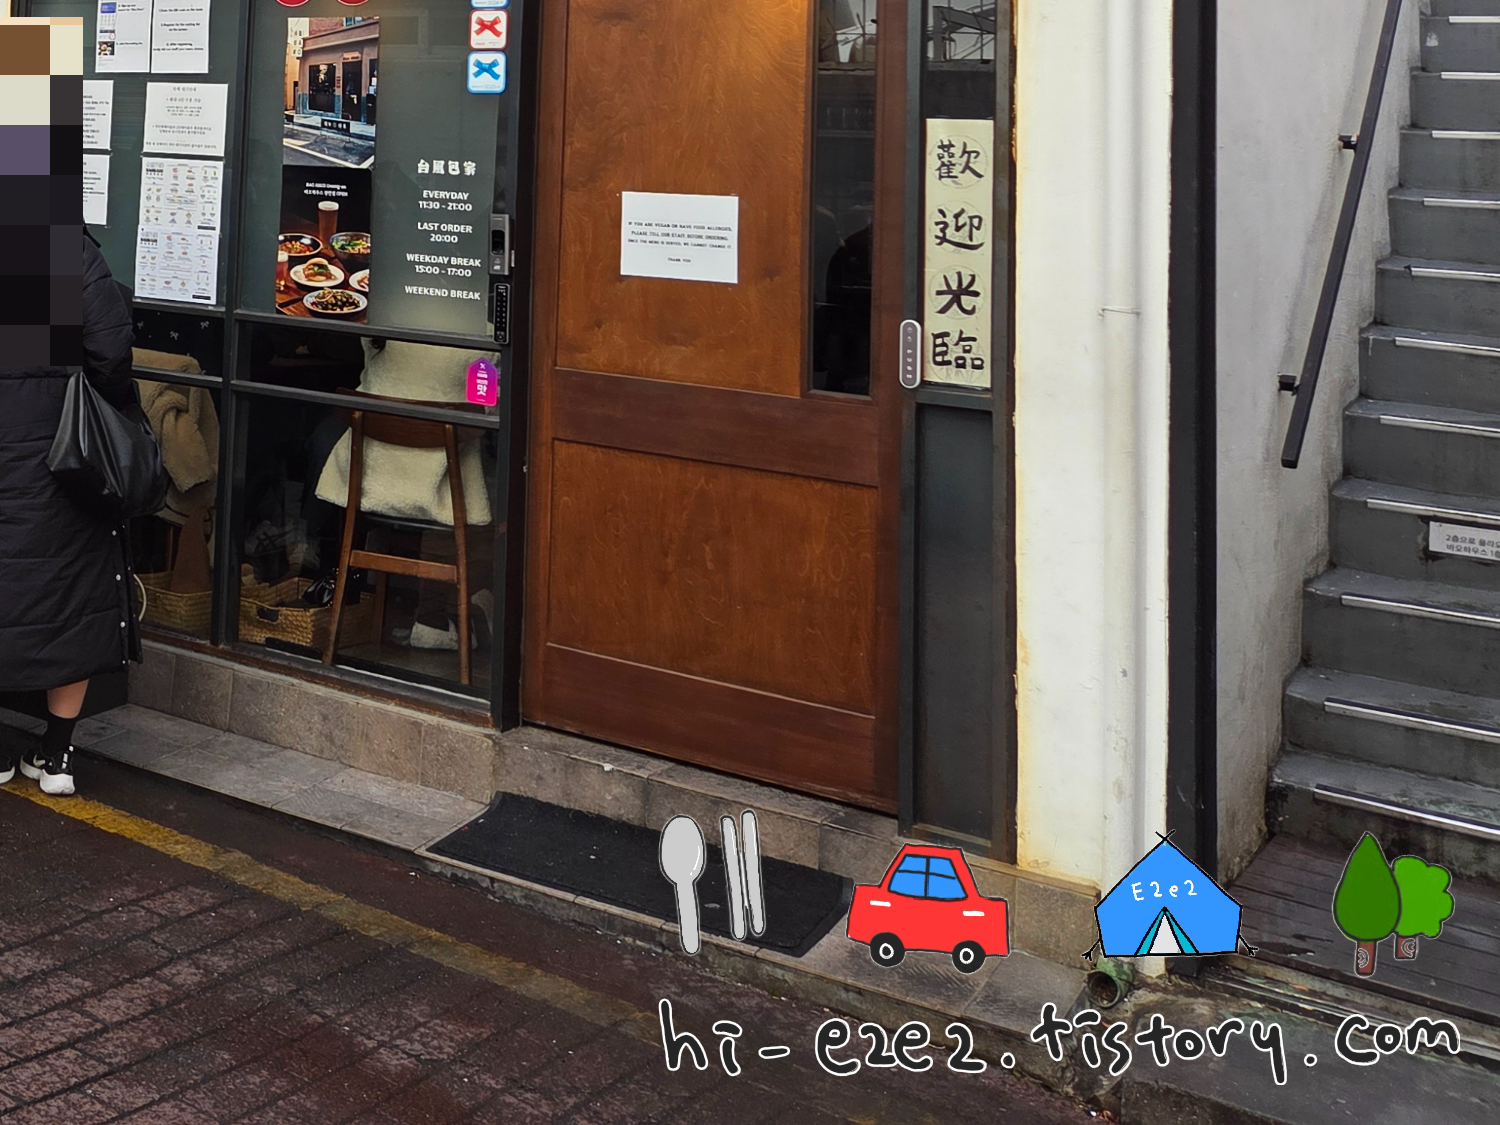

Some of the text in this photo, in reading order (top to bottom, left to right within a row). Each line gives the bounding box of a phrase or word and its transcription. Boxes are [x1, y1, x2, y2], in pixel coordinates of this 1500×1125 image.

[423, 190, 469, 200] EVERYDAY
[418, 201, 440, 210] 11:30
[447, 202, 473, 211] 21:00
[418, 222, 473, 233] LAST ORDER
[430, 233, 458, 243] 20:00
[406, 253, 481, 267] WEEKDAY BREAK
[931, 139, 985, 371] 歡迎光臨
[415, 265, 440, 274] 15:00
[447, 267, 472, 277] 17:00
[405, 286, 481, 300] WEEKEND BREAK
[476, 384, 488, 397] 맛
[1445, 534, 1476, 545] 2층으로
[1446, 544, 1488, 556] 바오하우스
